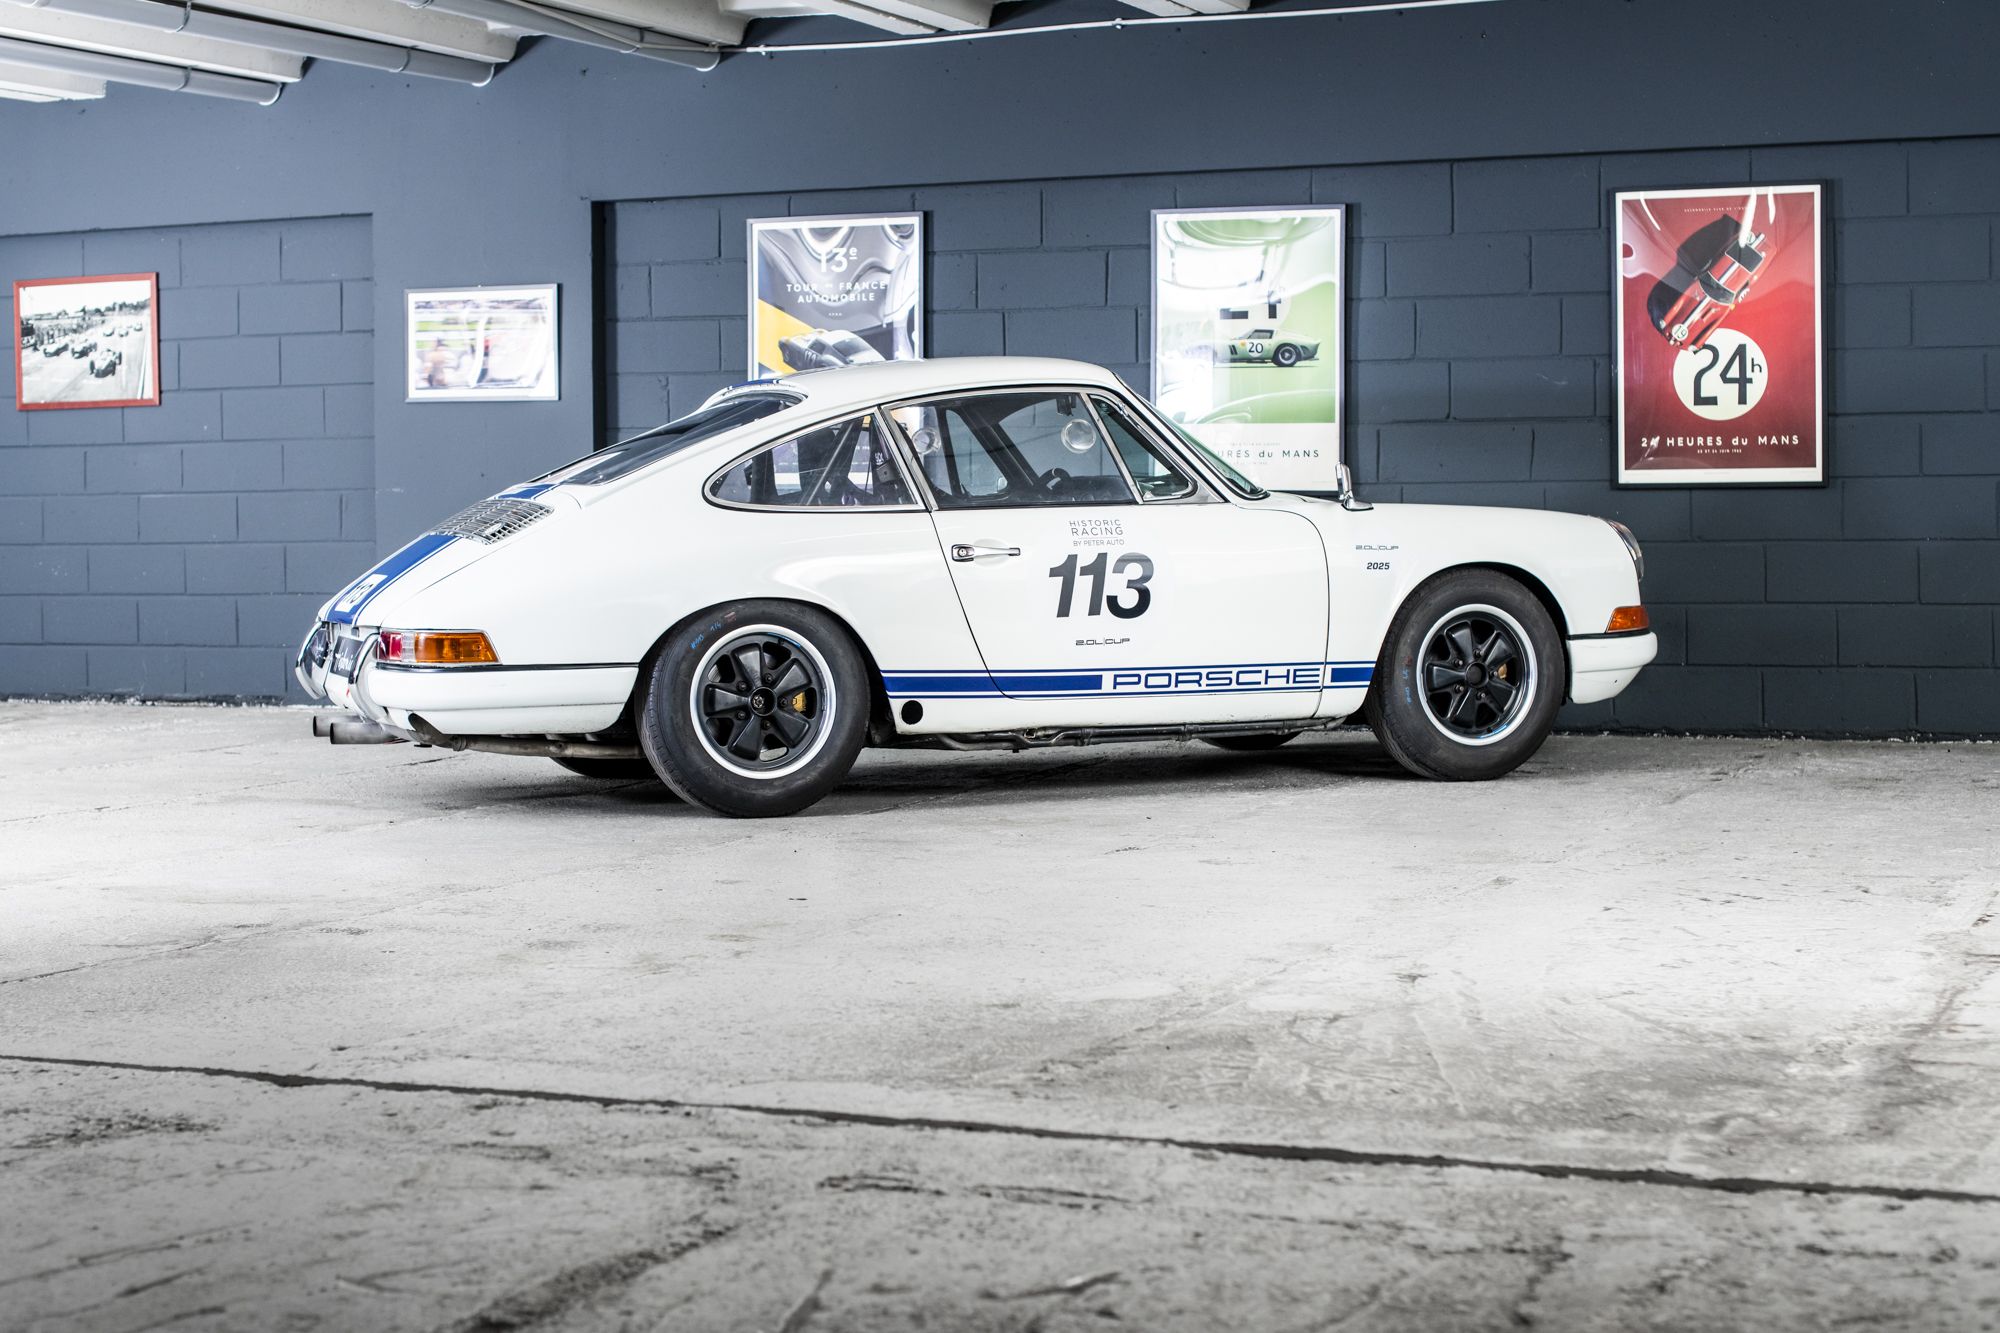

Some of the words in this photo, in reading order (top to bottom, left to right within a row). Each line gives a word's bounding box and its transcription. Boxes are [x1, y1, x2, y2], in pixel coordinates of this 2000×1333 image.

[786, 283, 818, 292] TOUR
[839, 280, 887, 290] FRANCE
[797, 292, 875, 303] AUTOMOBILE
[1248, 342, 1264, 353] 20
[1666, 436, 1722, 447] HEURES
[1731, 435, 1748, 446] du
[1758, 434, 1799, 446] MANS
[1258, 449, 1273, 458] du
[1282, 449, 1320, 458] MANS
[1069, 519, 1122, 527] HISTORIC
[1071, 526, 1124, 536] RACING
[1083, 539, 1104, 547] PETER
[1106, 538, 1125, 546] AUTO
[1366, 562, 1391, 570] 2025
[1048, 552, 1154, 619] 113
[1112, 668, 1321, 690] PORSCHE
